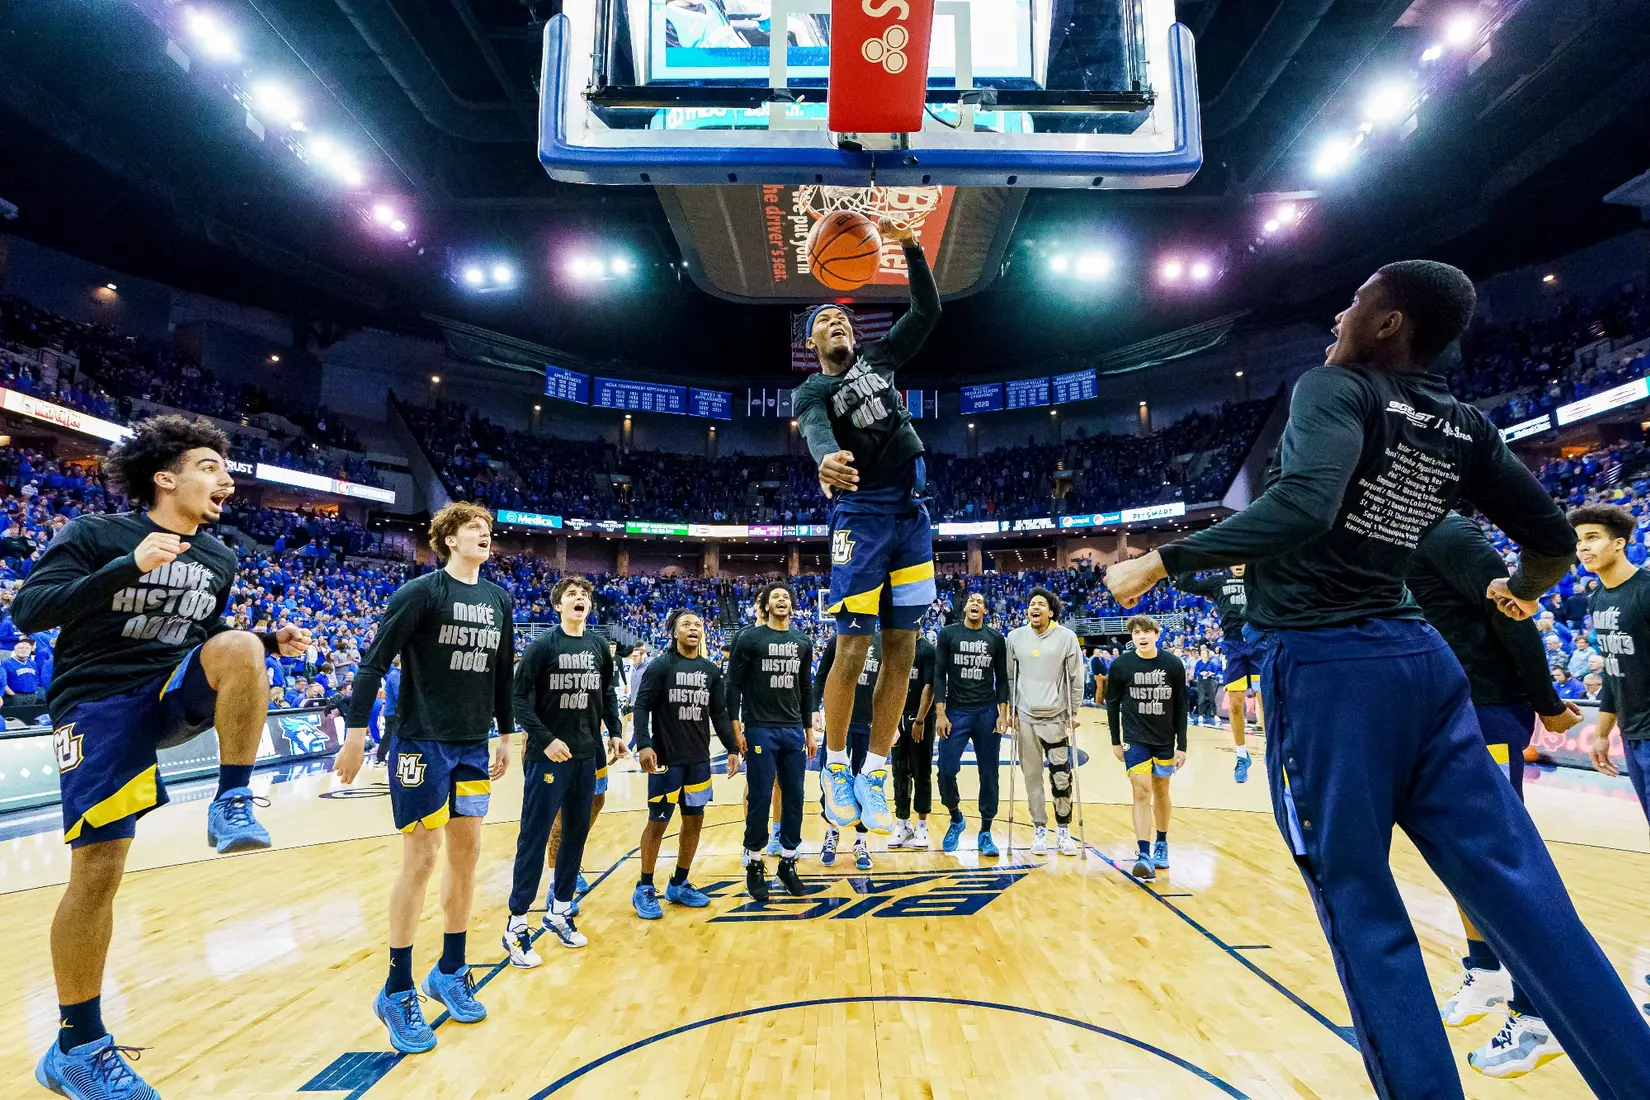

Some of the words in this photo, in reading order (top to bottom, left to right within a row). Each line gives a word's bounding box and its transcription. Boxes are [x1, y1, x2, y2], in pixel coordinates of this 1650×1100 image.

[763, 184, 785, 203] he
[765, 205, 789, 257] driver's
[788, 215, 809, 238] put
[772, 257, 789, 283] seat.
[973, 400, 990, 409] 2020
[1072, 518, 1090, 526] pepsi
[1104, 514, 1120, 523] pepsi
[396, 753, 427, 788] MU
[704, 893, 1003, 923] BIG
